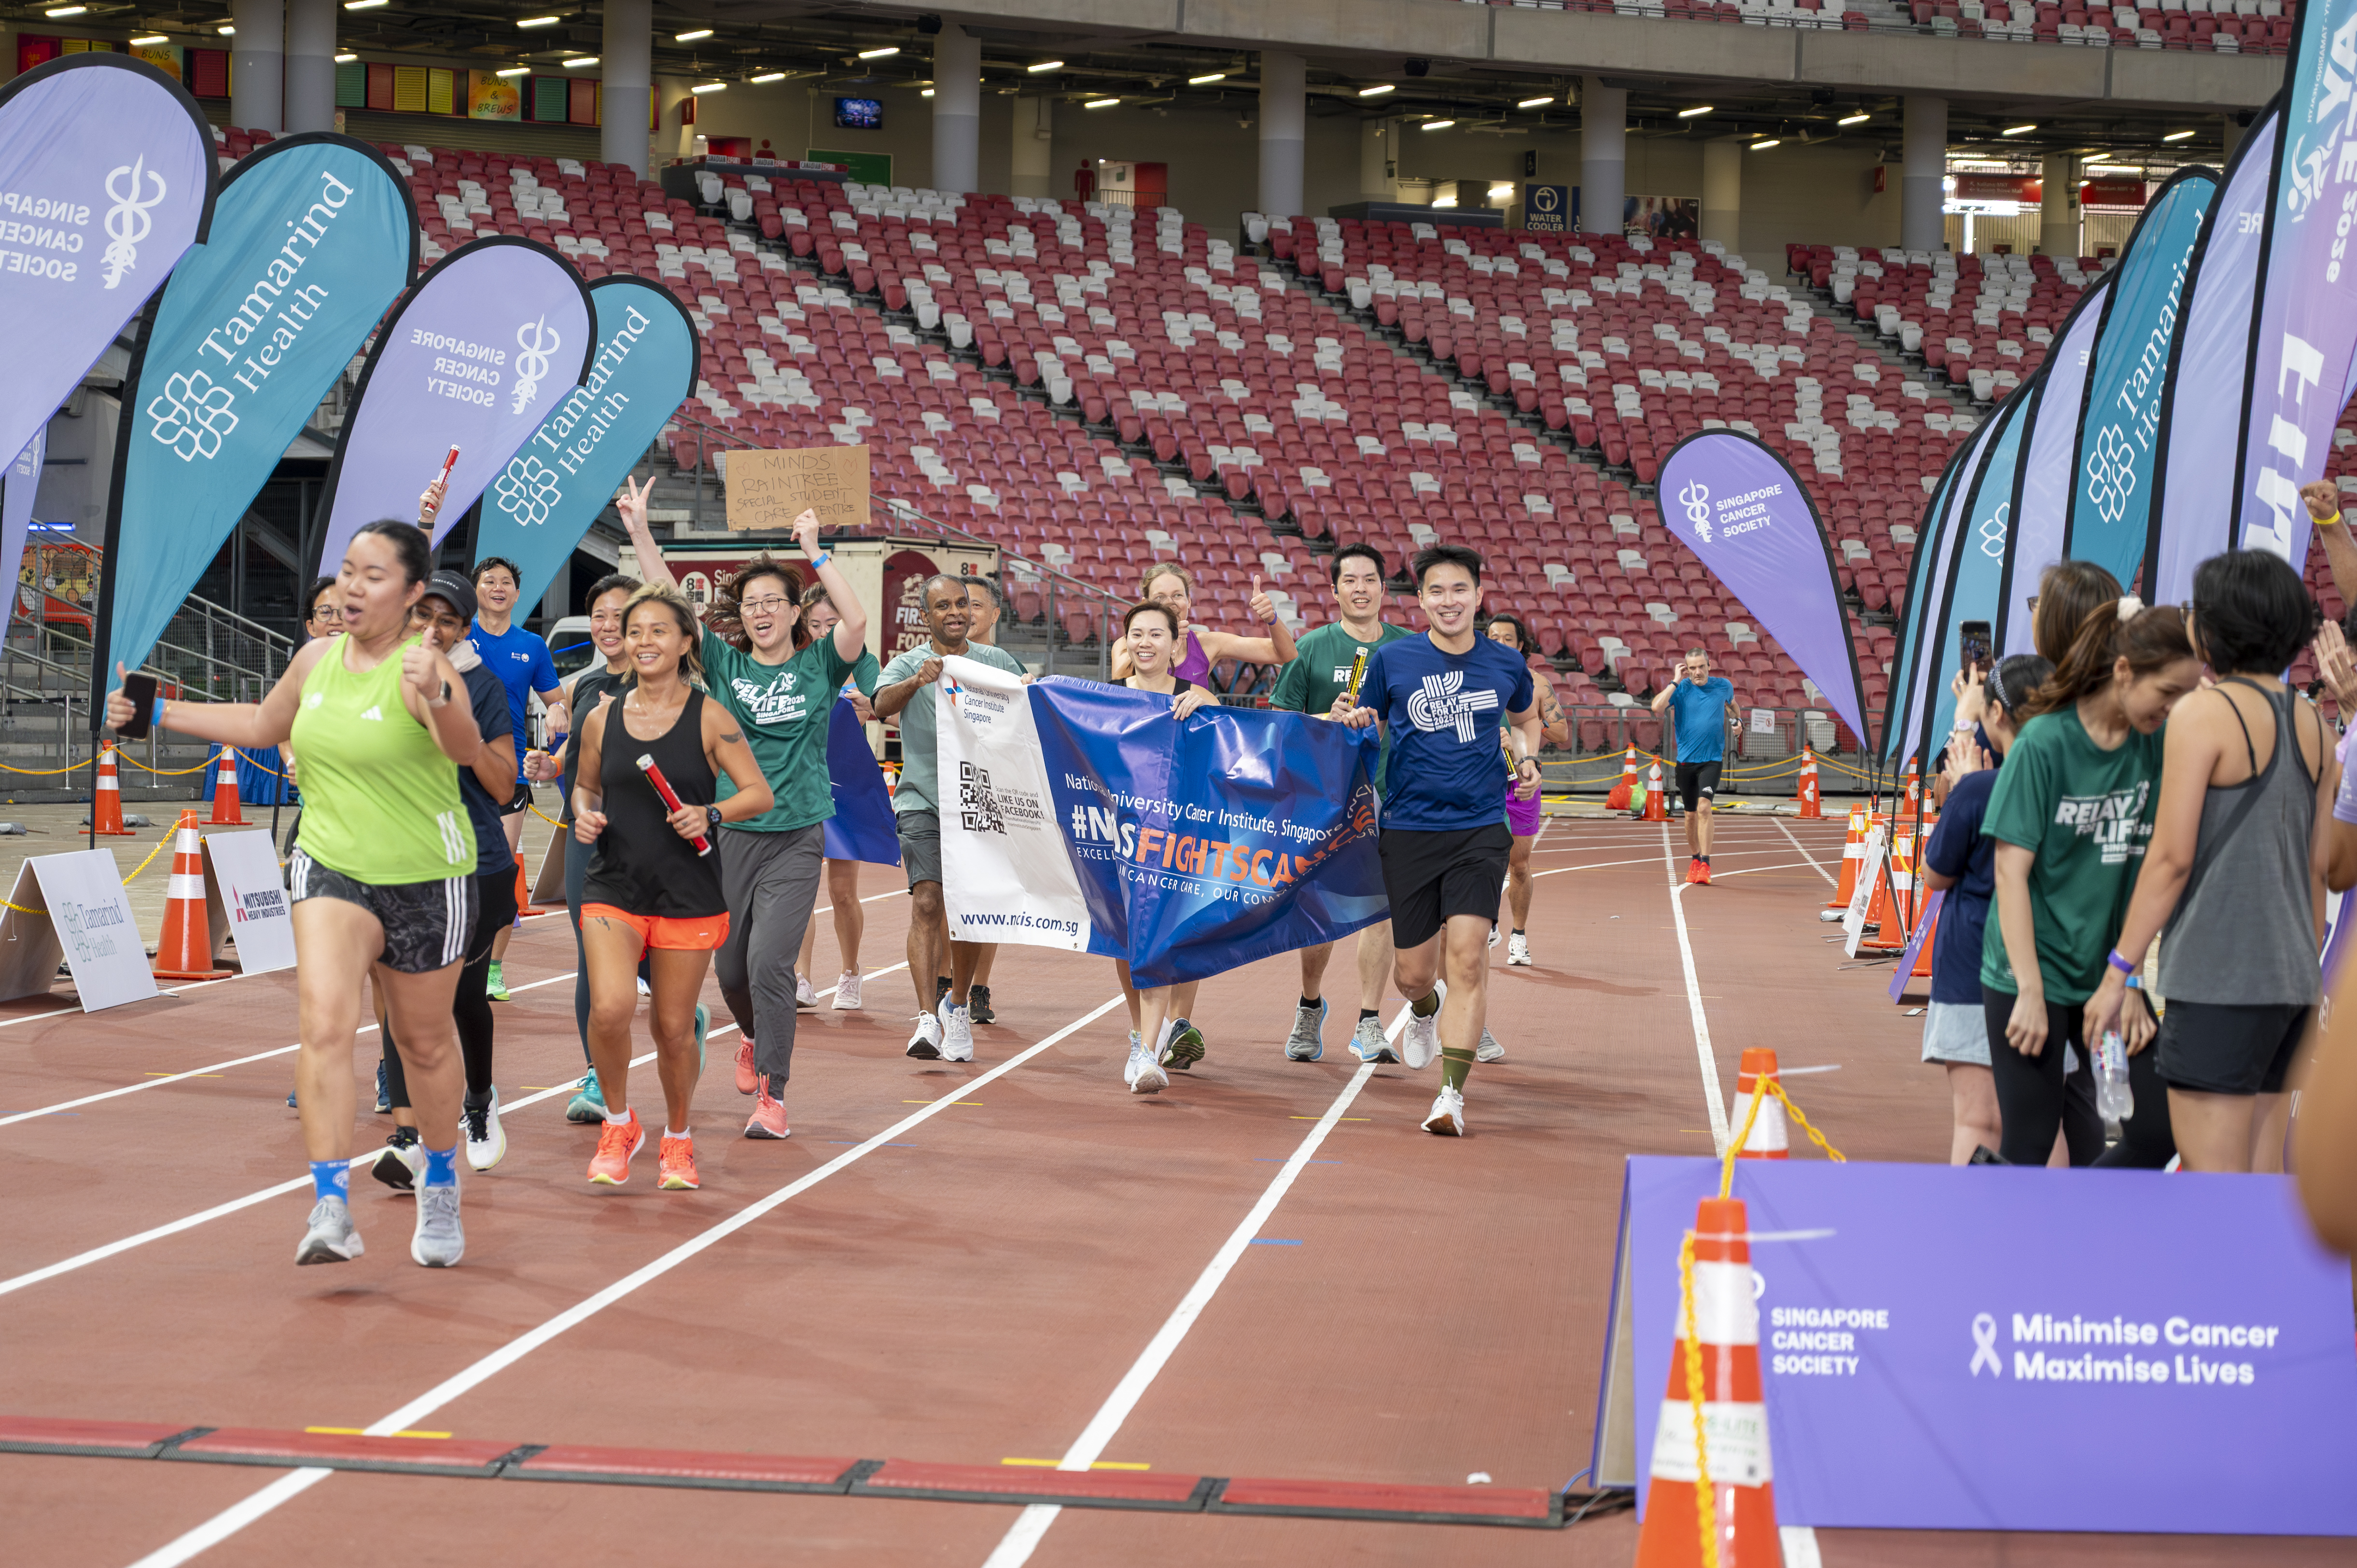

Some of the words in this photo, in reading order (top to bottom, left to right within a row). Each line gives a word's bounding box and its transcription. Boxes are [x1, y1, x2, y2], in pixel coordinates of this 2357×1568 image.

[141, 50, 170, 60] BUNS
[481, 76, 508, 86] BUNS
[490, 91, 498, 99] &
[477, 103, 514, 114] BREWS
[1527, 222, 1563, 232] COOLER
[1530, 214, 1562, 222] WATER
[197, 171, 353, 366] Tamarind
[233, 284, 329, 394] Health
[532, 305, 651, 453] Tamarind
[558, 391, 629, 475] Health
[764, 454, 830, 470] MINDS
[742, 473, 838, 494] RAINTREE
[736, 495, 783, 511] SPECIAL
[790, 487, 853, 503] STUDENT
[1716, 484, 1783, 511] SINGAPORE
[755, 508, 796, 523] CARE
[812, 504, 855, 518] CENTRE
[1720, 503, 1766, 524] CANCER
[1723, 515, 1771, 537] SOCIETY
[751, 694, 790, 712] LIFE
[787, 694, 806, 705] 2026
[962, 682, 984, 695] National
[983, 689, 1009, 704] University
[756, 705, 795, 718] SINGAPORE
[964, 694, 983, 708] Cancer
[984, 699, 1004, 713] Institute
[1429, 697, 1457, 710] RELAY
[1432, 707, 1449, 718] FOR
[1450, 703, 1470, 714] LIFE
[964, 708, 991, 723] Singapore
[1433, 714, 1454, 726] 2025
[1435, 721, 1455, 731] SINGAPORE
[997, 794, 1014, 805] LIKE
[1015, 796, 1025, 806] US
[1026, 799, 1039, 808] ON
[1065, 773, 1110, 798] National
[1108, 789, 1183, 821] University
[1219, 808, 1277, 836] Institute,
[1282, 819, 1343, 845] Singapore
[2054, 796, 2134, 825] RELAY
[1000, 805, 1045, 819] FACEBOOK!
[1119, 864, 1126, 877] IN
[1128, 870, 1177, 890] CANCER
[1181, 881, 1204, 898] CARE,
[1213, 887, 1239, 902] OUR
[243, 889, 282, 909] MITSUBISHI
[77, 897, 124, 929] Tamarind
[247, 909, 261, 920] HEAVY
[261, 905, 285, 918] INDUSTRIES
[961, 912, 1078, 936] www.ncis.com.sg
[89, 934, 117, 958] Health
[1771, 1306, 1890, 1329] SINGAPORE
[2012, 1313, 2159, 1346] Minimise
[2164, 1315, 2279, 1348] Cancer
[1771, 1331, 1855, 1351] CANCER
[1772, 1354, 1859, 1376] SOCIETY
[2013, 1351, 2169, 1383] Maximise
[2175, 1354, 2255, 1385] Lives
